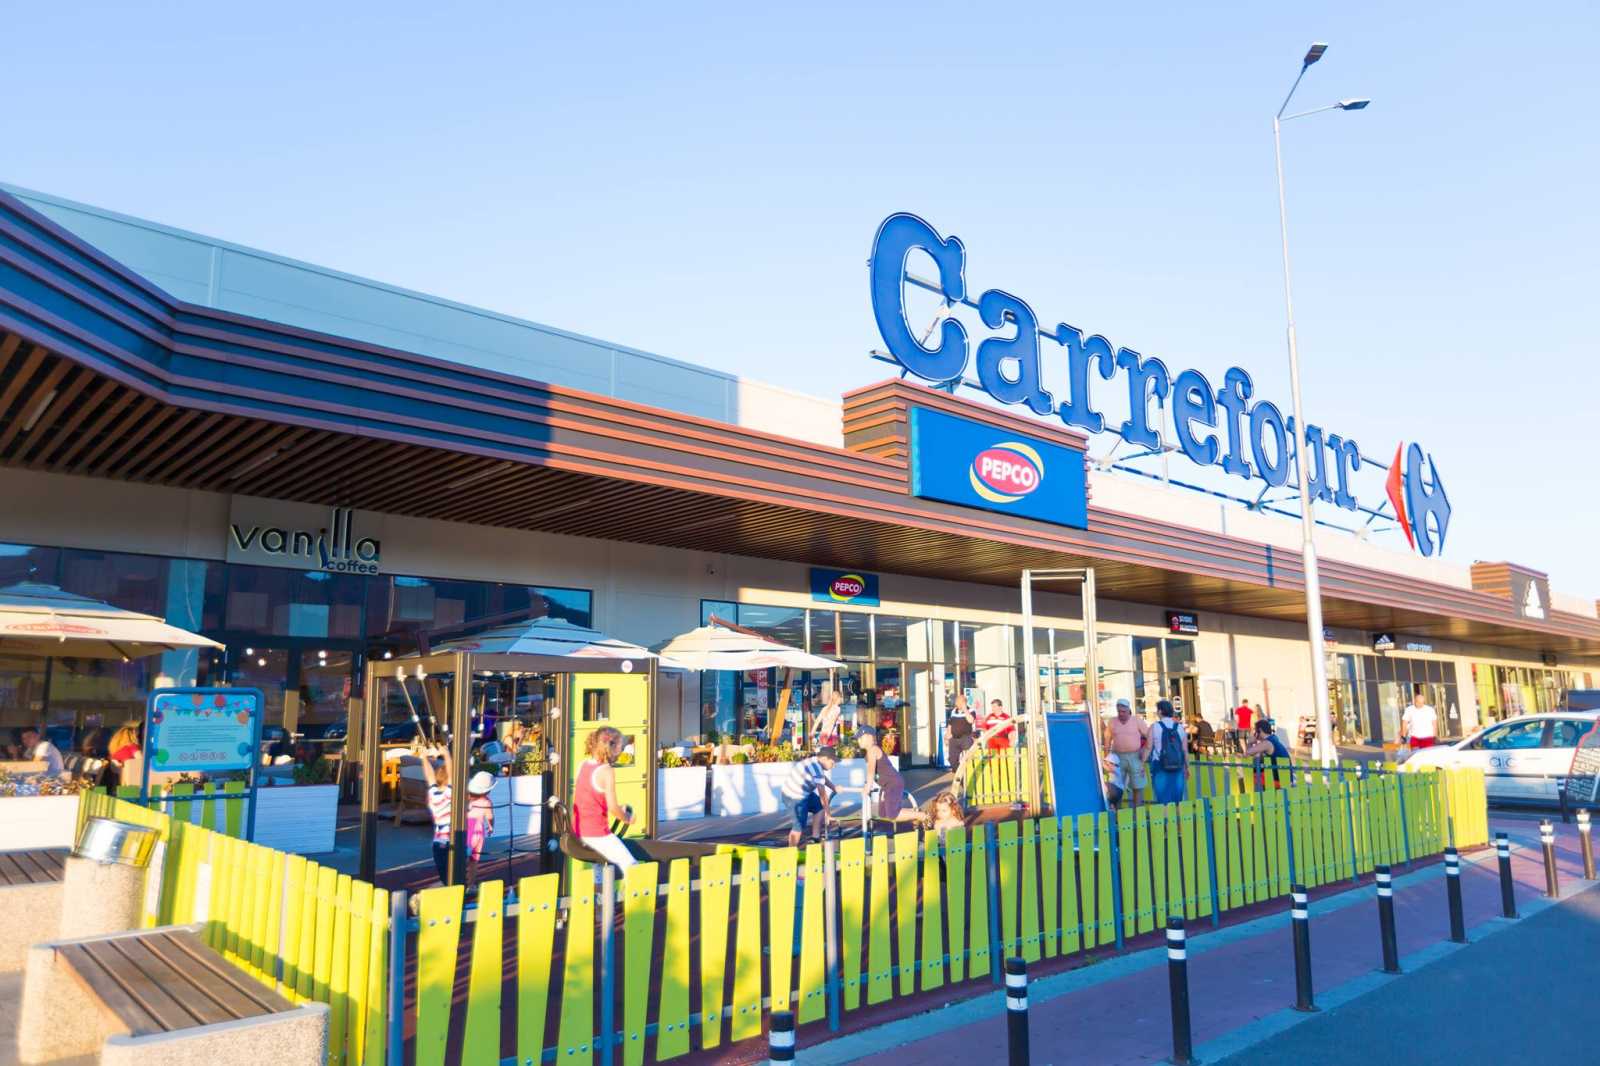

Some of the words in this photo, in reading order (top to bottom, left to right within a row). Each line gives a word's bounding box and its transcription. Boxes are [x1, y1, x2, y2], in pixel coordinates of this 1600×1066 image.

[871, 212, 1361, 512] Carrefour
[982, 456, 1034, 487] PEPCO
[231, 508, 380, 569] vanilla
[326, 560, 378, 574] coffee
[834, 582, 860, 593] PEPCO
